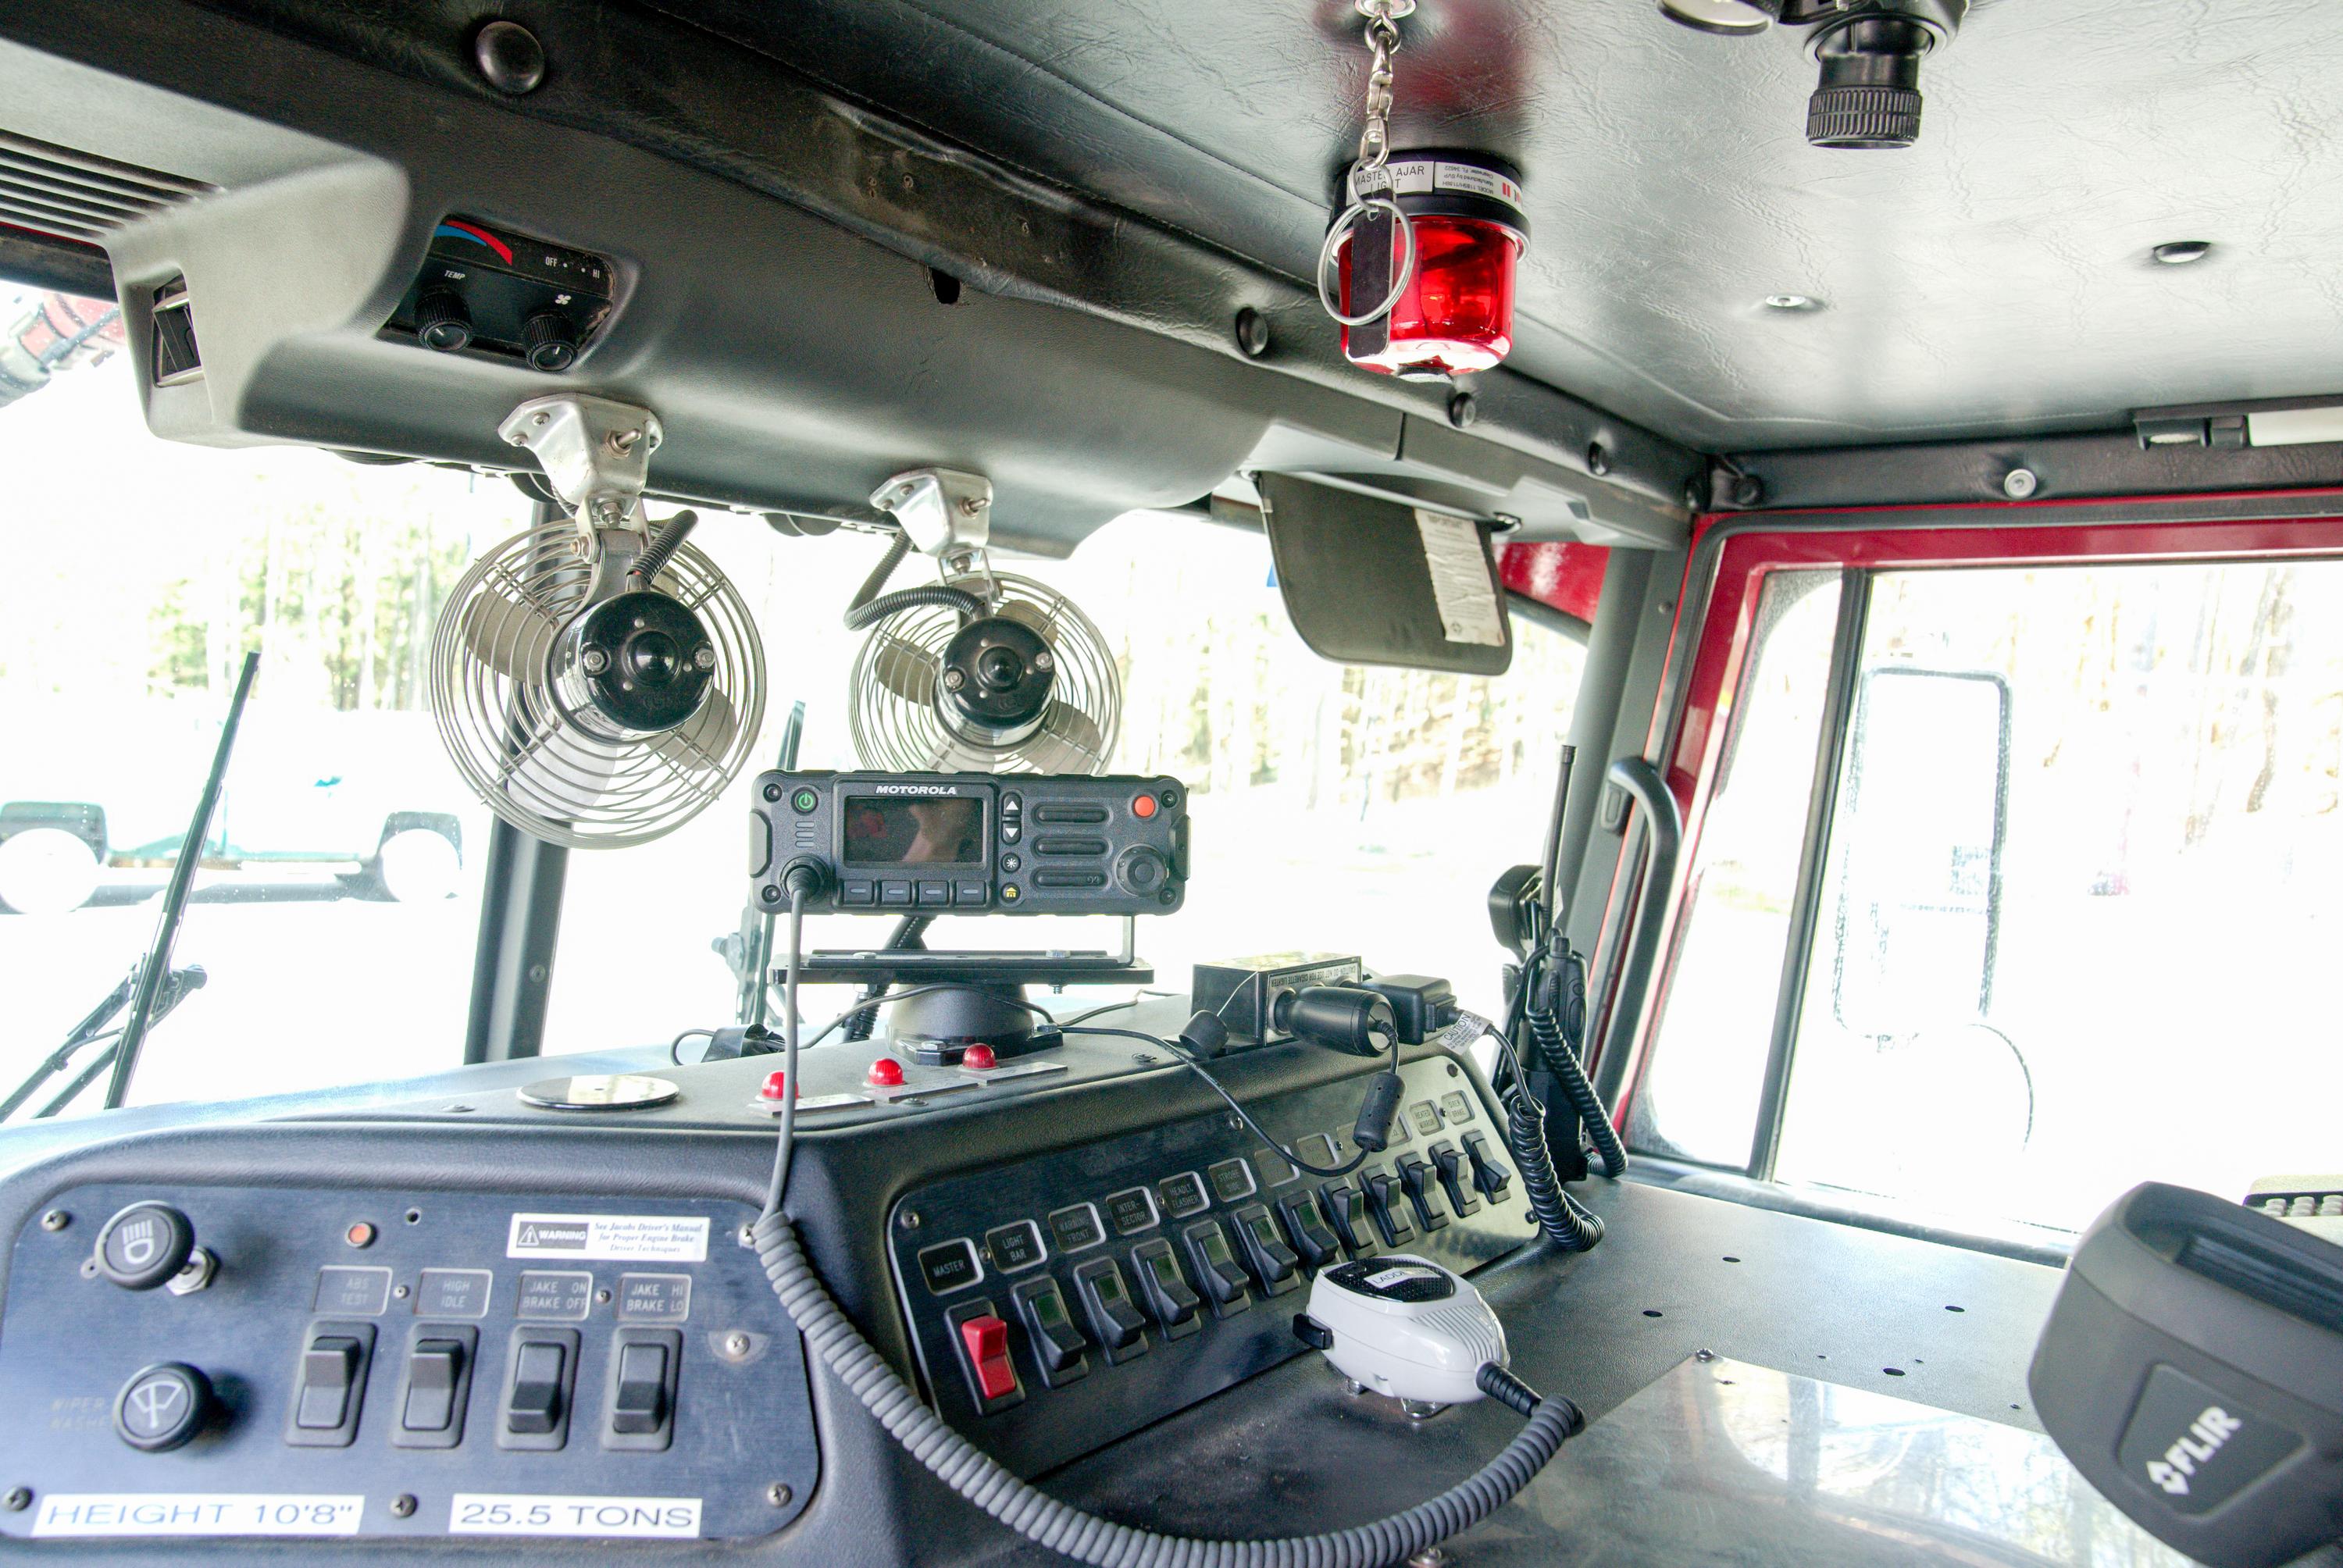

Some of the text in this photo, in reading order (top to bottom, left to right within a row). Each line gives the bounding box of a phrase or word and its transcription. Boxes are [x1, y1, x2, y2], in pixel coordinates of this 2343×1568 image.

[1396, 166, 1425, 177] AJAR
[1370, 179, 1402, 193] LIGT
[444, 269, 466, 280] TEMP
[545, 256, 601, 280] OFF HI
[876, 785, 957, 795] MOTOROLA
[1271, 977, 1287, 987] LIGHTER
[1288, 974, 1308, 985] CIGARETTE
[1443, 1013, 1471, 1041] CAUTION
[1117, 1200, 1140, 1211] INTER-
[1172, 1195, 1200, 1209] FLASHER
[1059, 1216, 1090, 1232] WARNING
[1121, 1212, 1147, 1227] SECTOR
[594, 1223, 703, 1233] See Jacobs Driver's Manual
[537, 1229, 587, 1241] WARNING
[598, 1234, 611, 1242] for
[612, 1234, 637, 1244] Proper
[640, 1235, 669, 1244] Engine
[1002, 1234, 1024, 1249] LIGHT
[1067, 1228, 1091, 1243] FRONT
[610, 1243, 681, 1253] Driver Techniques
[1009, 1249, 1027, 1263] BAR
[933, 1259, 966, 1278] MASTER
[346, 1277, 370, 1289] ABS
[444, 1279, 471, 1292] HIGH
[530, 1281, 587, 1294] JAKE ON
[631, 1284, 684, 1297] JAKE HI
[341, 1293, 368, 1306] TEST
[440, 1295, 467, 1308] IDLE
[522, 1296, 587, 1310] BRAKE OFF
[626, 1299, 684, 1313] BRAKE LO
[2163, 1406, 2242, 1477] FLIR
[47, 1502, 354, 1526] HEIGHT 10'8"
[460, 1502, 694, 1529] 25.5 TONS
